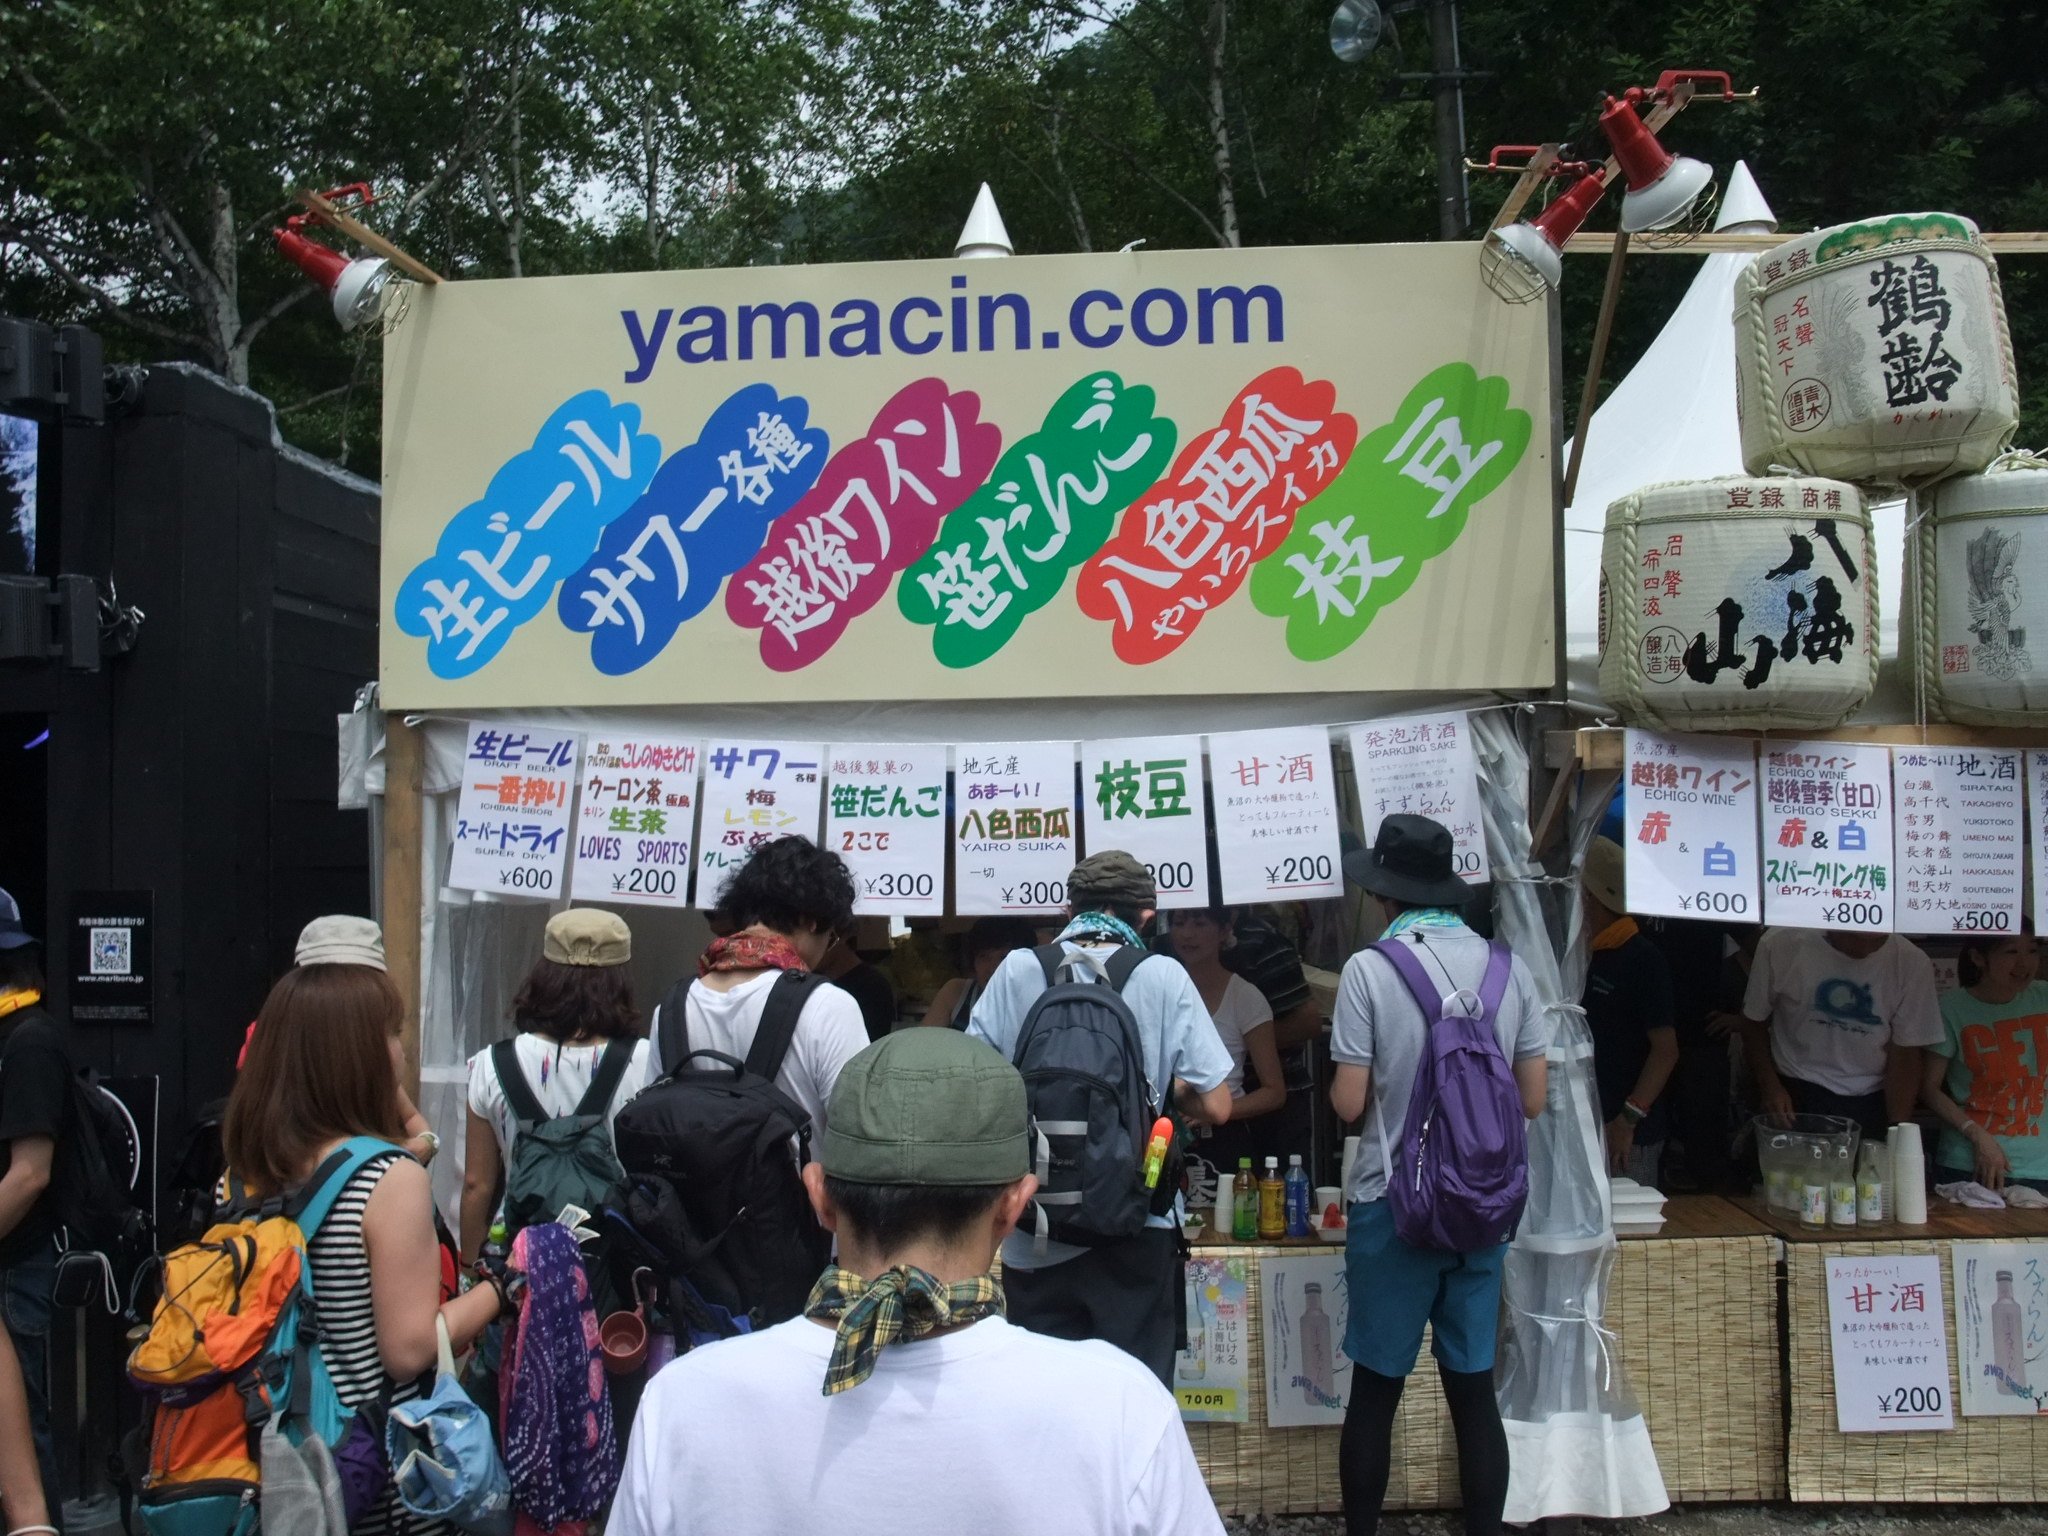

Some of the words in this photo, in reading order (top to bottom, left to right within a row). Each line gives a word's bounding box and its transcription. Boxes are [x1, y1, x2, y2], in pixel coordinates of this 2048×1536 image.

[1763, 249, 1813, 285] 登録
[620, 275, 1284, 384] yamacin.com
[916, 377, 1154, 631] 笹だんご
[1099, 394, 1323, 632] 八色西瓜
[1284, 396, 1503, 626] 枝豆
[745, 401, 962, 652] 越後ワイン
[418, 419, 633, 662] 生ビール
[1151, 440, 1340, 642] やいろスイカ
[1682, 518, 1860, 690] 八海山
[468, 730, 574, 768] 生ビール
[1364, 721, 1457, 750] 発泡清酒
[621, 743, 696, 774] こしのゆきどけ
[709, 746, 818, 780] サワー
[1368, 744, 1427, 760] SPARKLING
[1430, 740, 1457, 751] SAKE
[1768, 752, 1857, 770] 越後ワイン
[483, 761, 521, 770] DRAFT
[527, 764, 556, 774] BEER
[795, 773, 817, 784] 各種
[832, 759, 914, 776] 越後製菓の
[962, 755, 1021, 775] 地元産
[1229, 753, 1315, 787] 甘酒
[1631, 760, 1752, 794] 越後ワイン
[1768, 767, 1815, 779] ECHIGO
[1818, 770, 1848, 781] WINE
[1955, 753, 2016, 780] 地酒
[473, 775, 566, 808] 一番搾り
[588, 775, 662, 806] ウーロン茶
[746, 789, 776, 806] 梅
[831, 783, 942, 819] 笹だんご
[1094, 758, 1192, 821] 枝豆
[1644, 788, 1698, 803] ECHIGO
[1702, 793, 1736, 806] WINE
[1960, 784, 2014, 792] SIRATAKI
[480, 803, 519, 814] ICHIBAN
[1375, 790, 1456, 815] すずらん
[1774, 804, 1825, 816] ECHIGO
[1830, 807, 1877, 820] SEKKI
[1904, 796, 1950, 808] 高千代
[1961, 800, 2014, 808] TAKACHIYO
[583, 805, 606, 818] キリン
[607, 806, 668, 836] 生茶
[724, 808, 798, 827] レモン
[958, 807, 1071, 840] 八色西瓜
[1963, 818, 2014, 826] YUKIOTOKO
[457, 819, 565, 855] スーパードライ
[842, 830, 890, 852] 2こで
[961, 842, 1011, 852] YAIRO
[1017, 841, 1067, 852] SUIKA
[1637, 810, 1672, 845] 赤
[1678, 842, 1689, 854] &
[1703, 840, 1736, 876] 白
[1777, 817, 1808, 848] 赤
[1810, 830, 1829, 850] &
[1838, 819, 1866, 851] 白
[1962, 834, 1995, 842] UMENO
[1998, 834, 2014, 842] MAI
[475, 847, 515, 858] SUPER
[522, 851, 547, 861] DRY
[579, 835, 622, 861] LOVES
[637, 838, 689, 866] SPORTS
[1906, 845, 1952, 859] 長者盛
[499, 866, 553, 890] ¥600
[612, 867, 676, 895] ¥200
[1265, 855, 1332, 884] ¥200
[1766, 858, 1887, 891] スパークリング梅
[1907, 864, 1952, 876] 八海山
[1962, 868, 2014, 876] HAKKAISAN
[864, 873, 934, 897] ¥300
[1001, 881, 1065, 905] ¥300
[1962, 886, 2014, 894] SOUTENBOH
[1678, 891, 1748, 915] ¥600
[1822, 902, 1884, 925] ¥800
[1961, 902, 1987, 910] KOSINO
[1952, 911, 2009, 931] ¥500
[1845, 1283, 1925, 1314] 甘酒
[1225, 1320, 1238, 1366] はじける
[1291, 1374, 1313, 1392] awa
[1313, 1386, 1342, 1410] sweet
[1983, 1363, 2004, 1381] awa
[2005, 1375, 2034, 1400] sweet
[1184, 1394, 1223, 1406] 700円
[1877, 1387, 1942, 1414] ¥200
